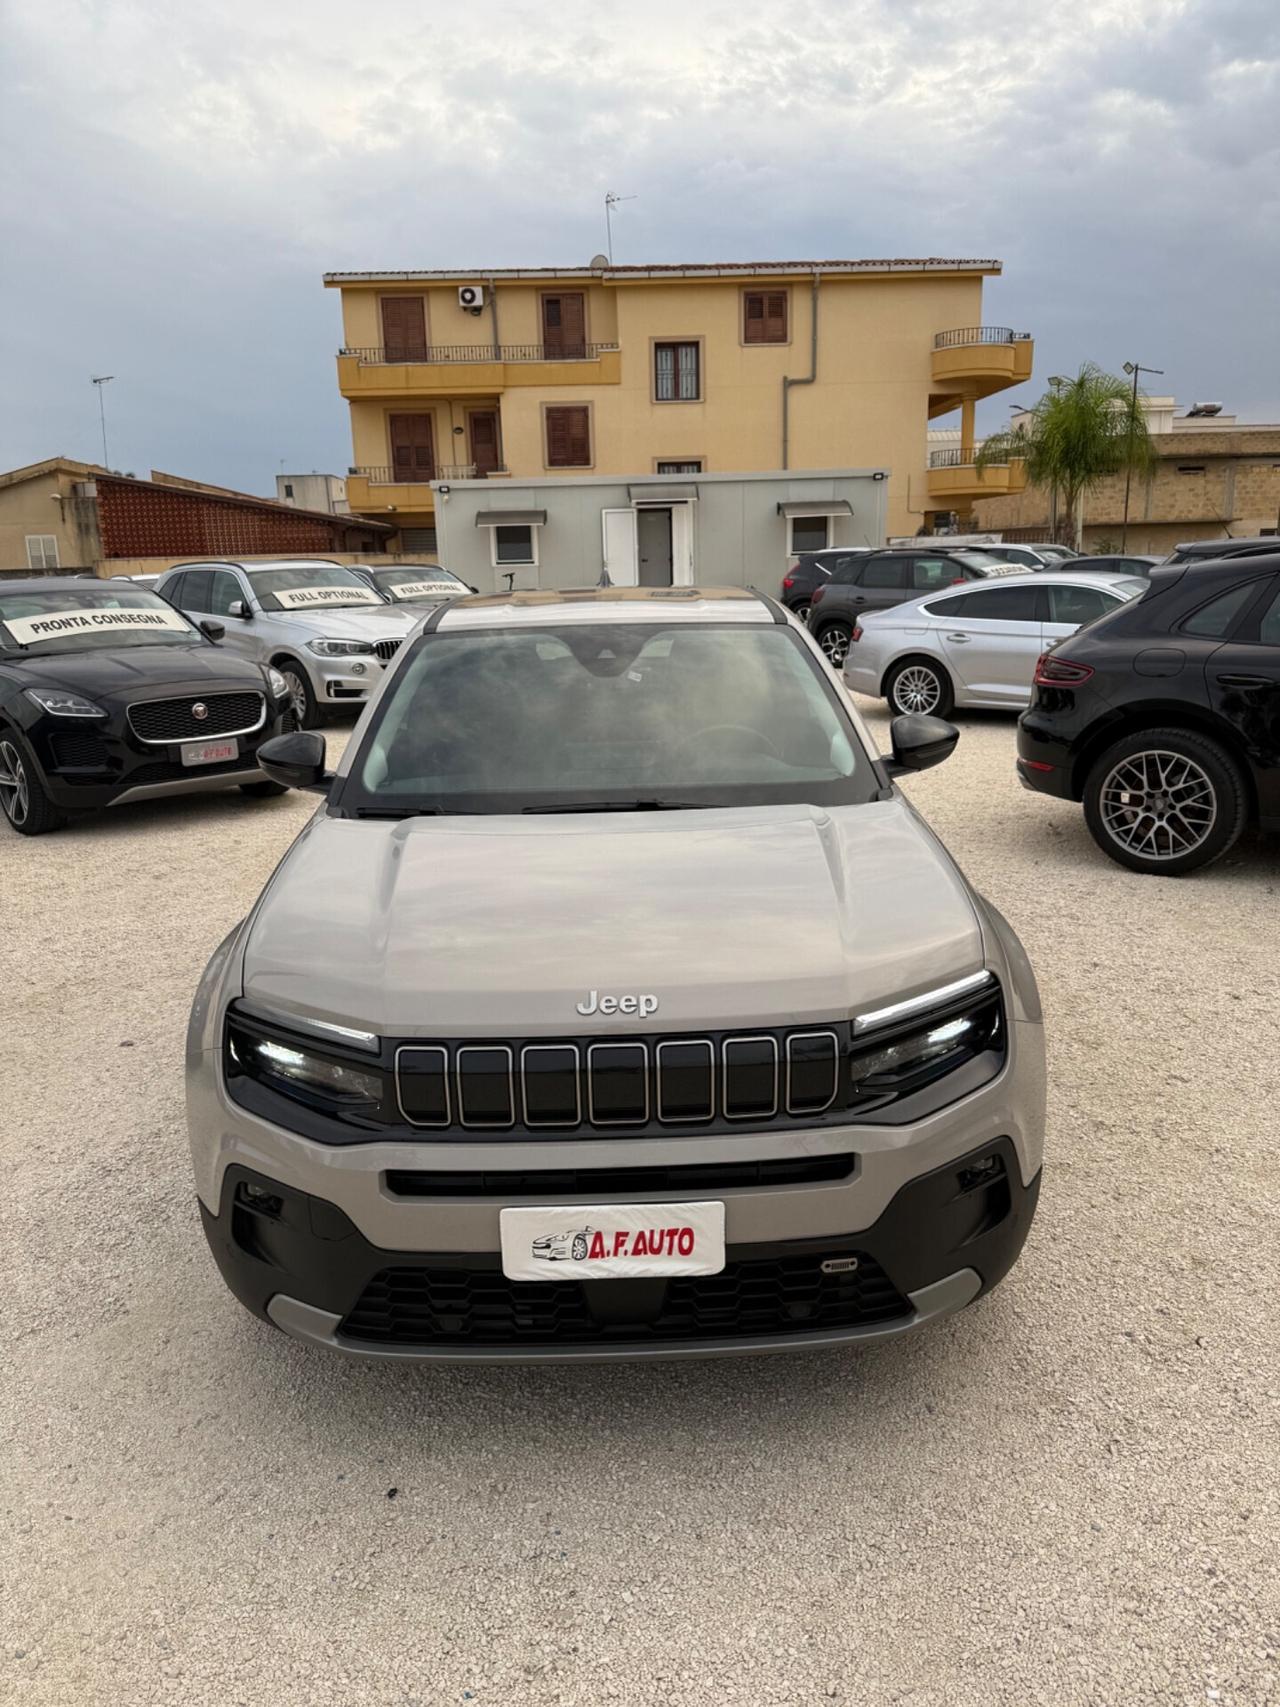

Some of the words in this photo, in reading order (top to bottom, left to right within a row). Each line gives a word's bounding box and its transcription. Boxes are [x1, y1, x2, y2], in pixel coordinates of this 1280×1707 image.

[288, 592, 319, 604] FULL
[318, 590, 370, 601] OPTIONAL
[30, 616, 92, 634] PRONTA
[92, 614, 168, 626] CONSEGNA
[576, 990, 659, 1019] Jeep
